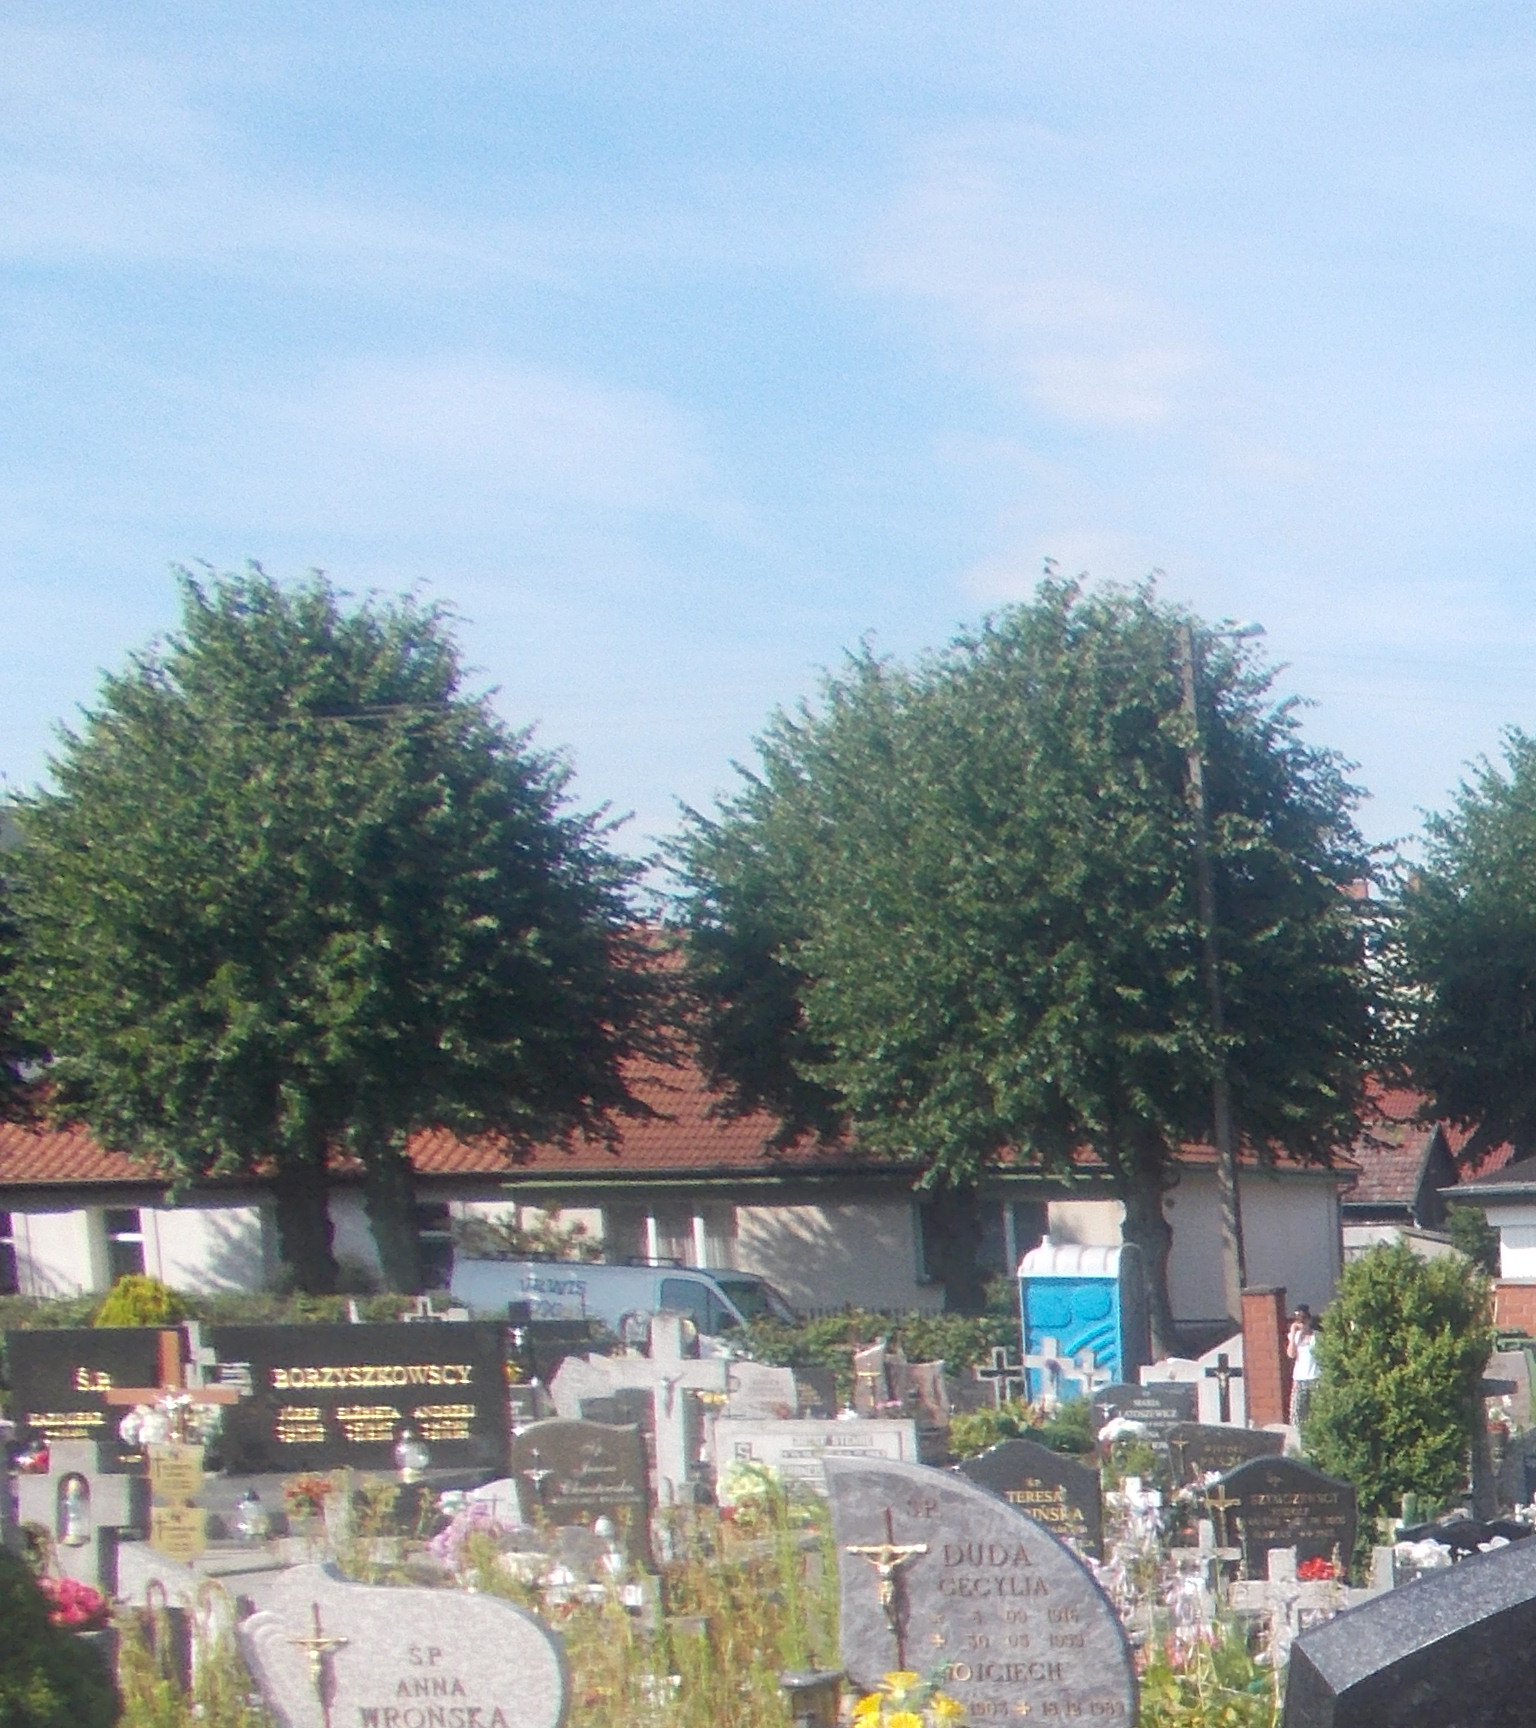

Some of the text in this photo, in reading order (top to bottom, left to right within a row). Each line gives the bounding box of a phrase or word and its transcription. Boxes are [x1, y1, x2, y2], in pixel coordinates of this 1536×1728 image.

[271, 1364, 473, 1388] BORZYSZKOWSCY
[1003, 1489, 1066, 1504] TERESA
[943, 1543, 1033, 1568] DUDA
[937, 1576, 1049, 1598] CECYLIA
[396, 1677, 467, 1698] ANNA
